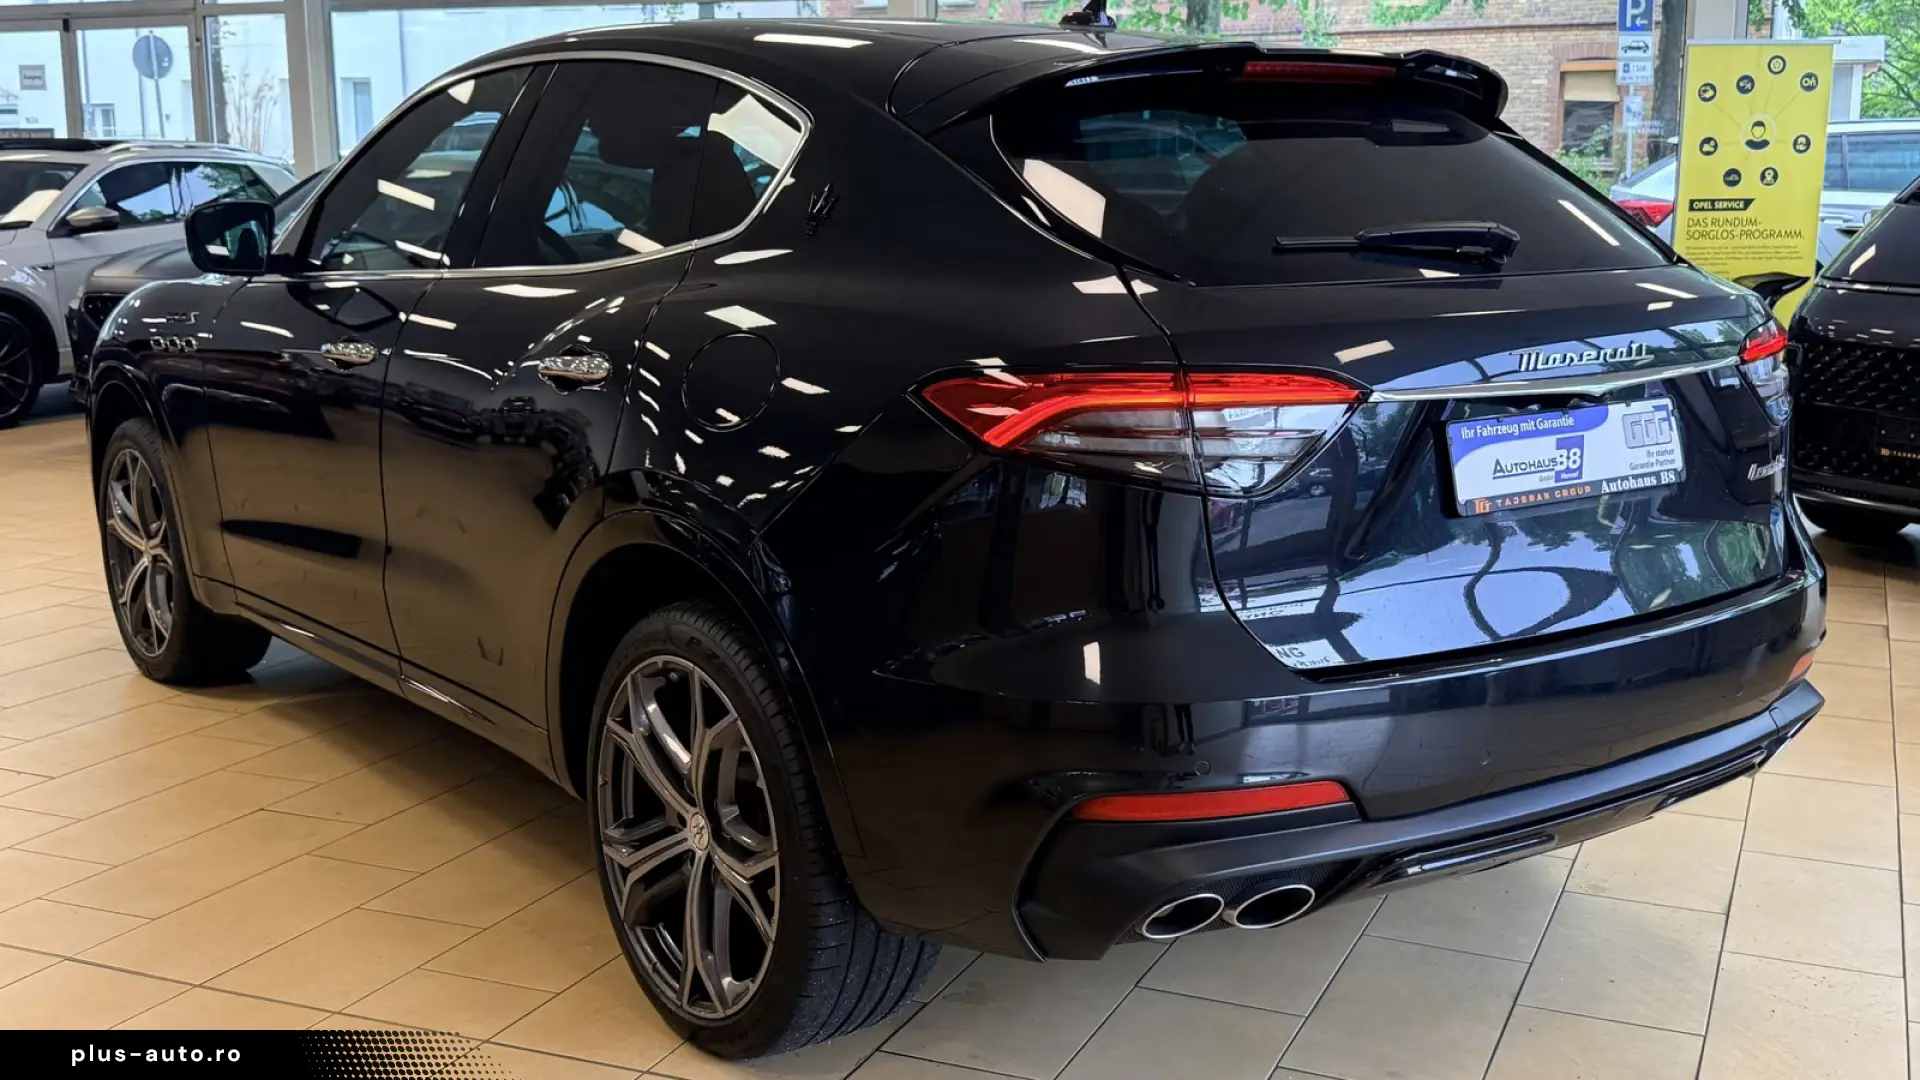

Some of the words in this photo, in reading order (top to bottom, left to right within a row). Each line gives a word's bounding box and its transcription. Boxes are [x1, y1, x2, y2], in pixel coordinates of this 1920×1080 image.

[1625, 0, 1646, 28] P
[1692, 201, 1713, 210] OPEL
[1714, 200, 1745, 209] SERVICE
[1686, 217, 1709, 229] DAS
[1711, 217, 1762, 228] RUNDUM-
[1686, 229, 1805, 241] SORGLOS-PROGRAMM.
[1509, 340, 1655, 371] Maserati
[1461, 426, 1475, 440] Ihr
[1476, 423, 1519, 438] Fahrzeug
[1520, 419, 1536, 433] mit
[1536, 415, 1575, 430] Garantie
[1555, 447, 1582, 471] B8
[1554, 486, 1592, 498] GROUP
[1601, 476, 1657, 494] Autohaus
[1660, 470, 1676, 485] B8
